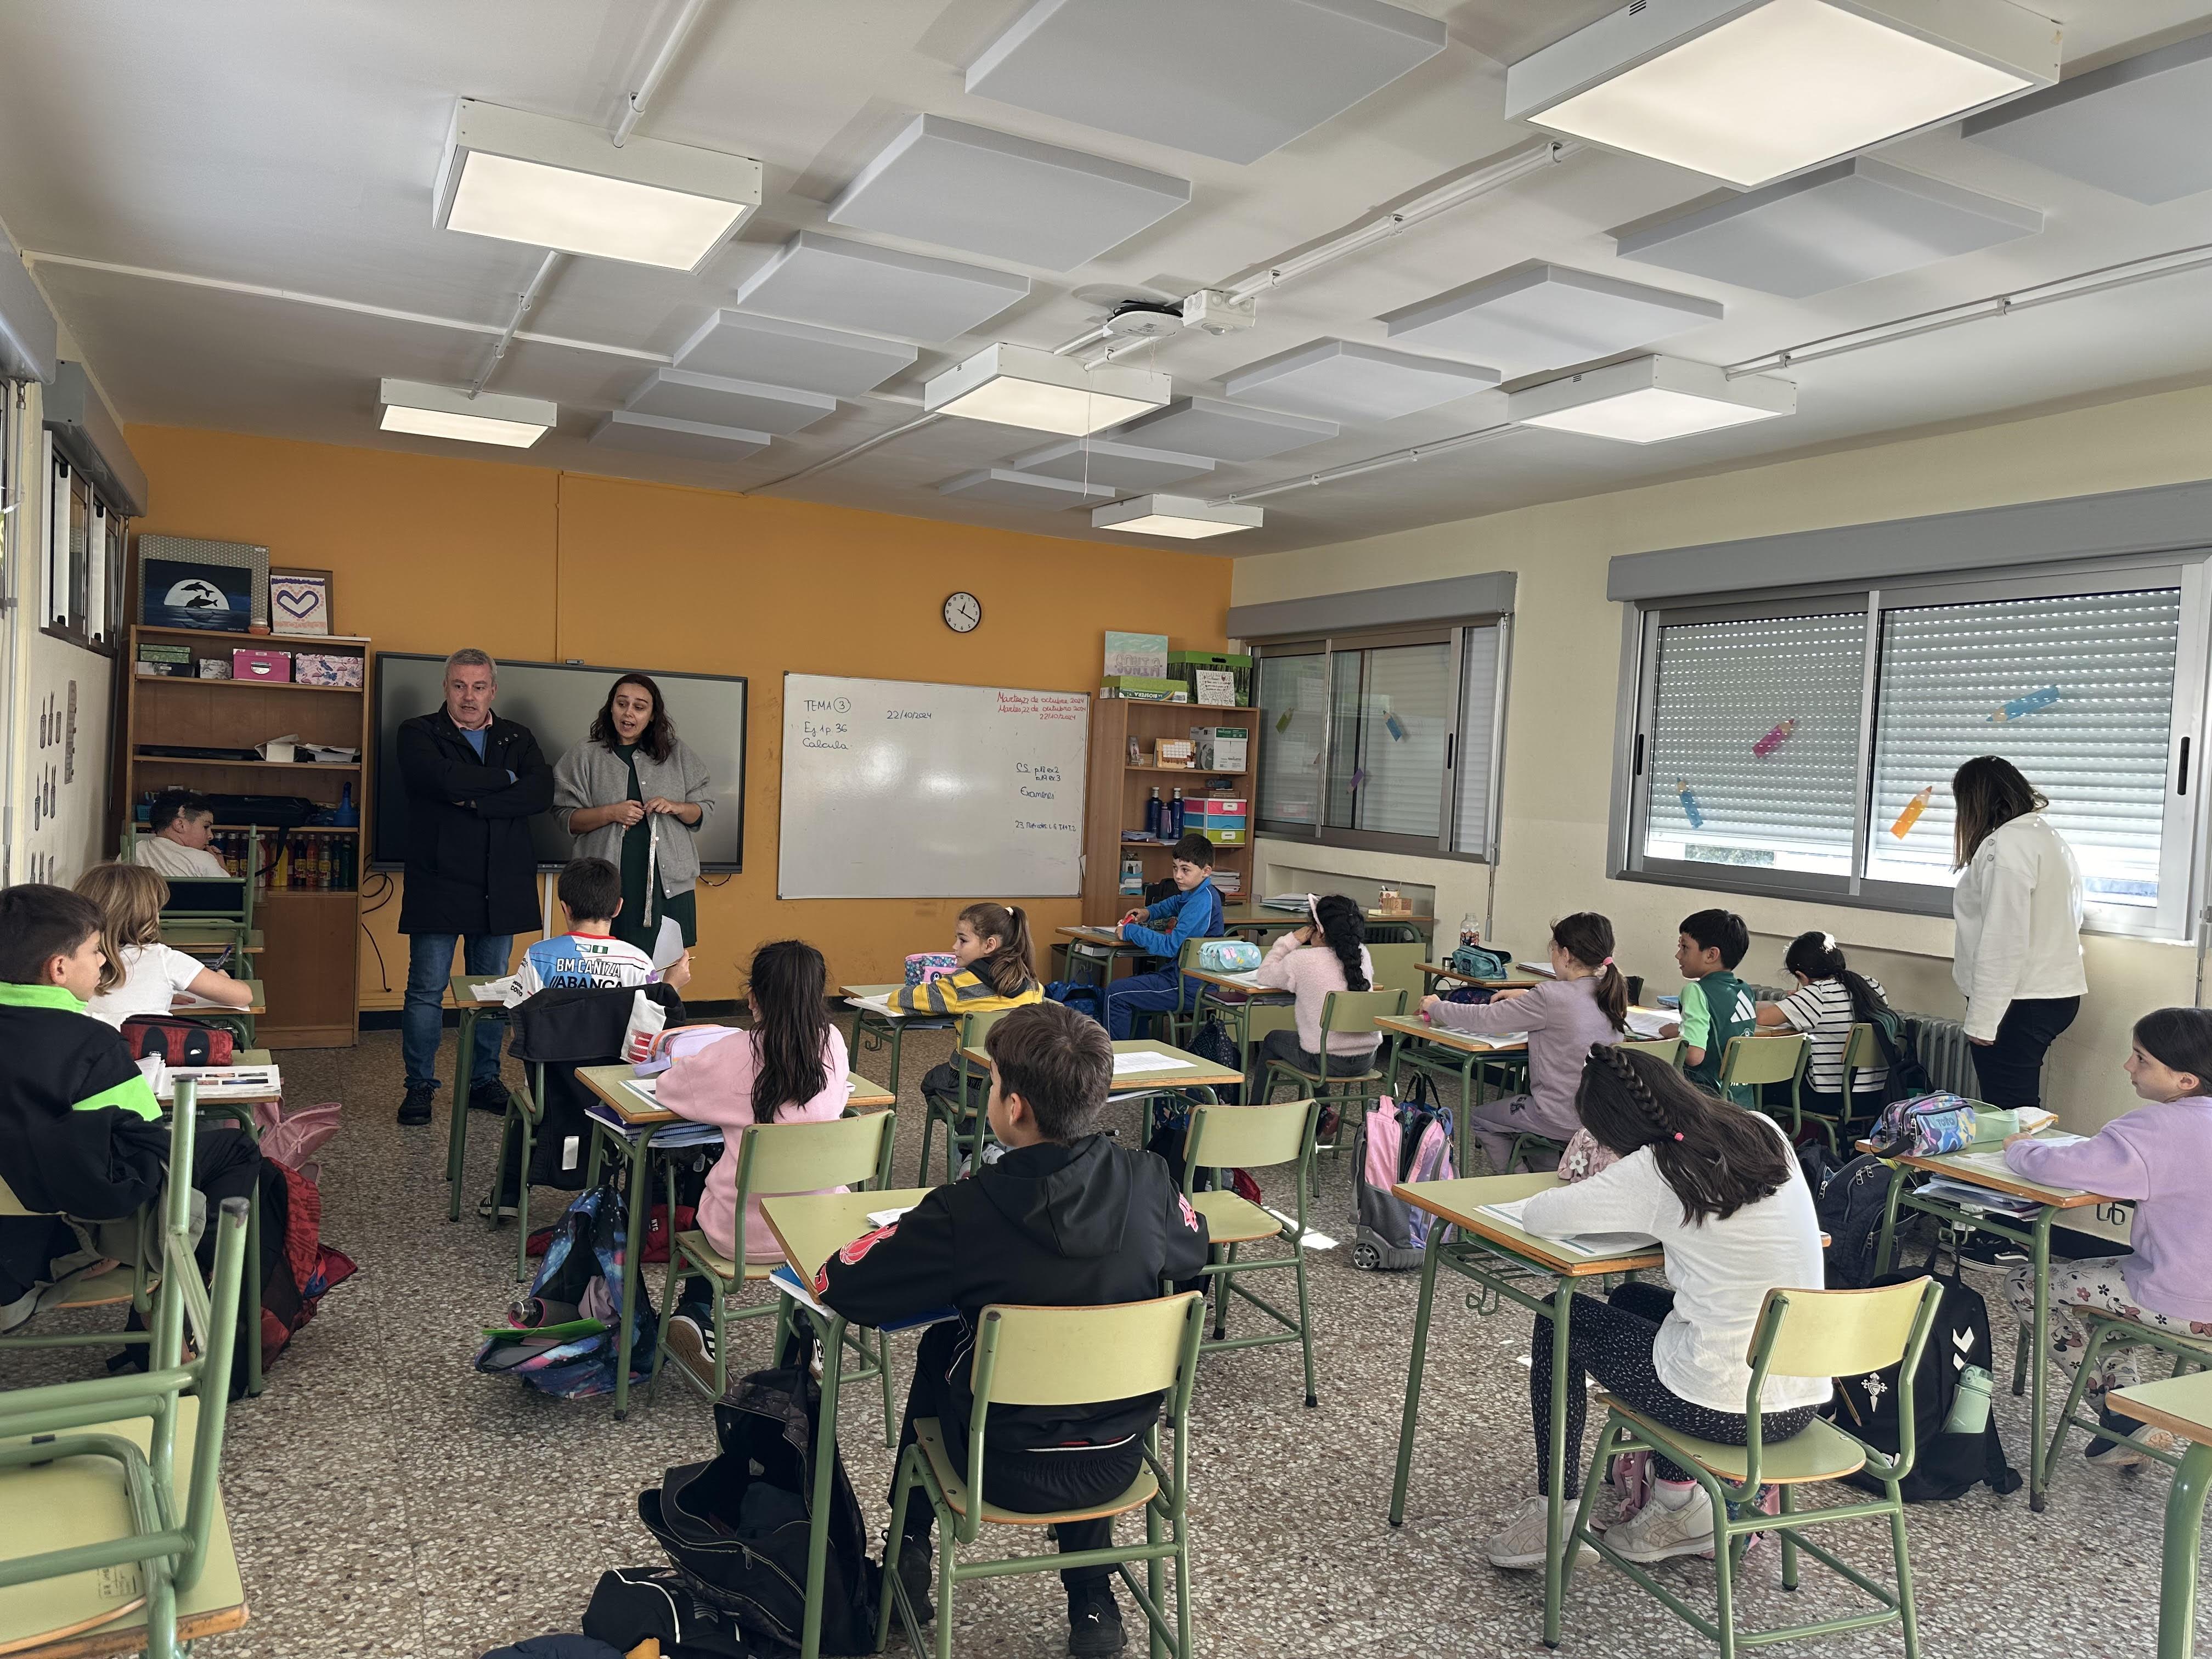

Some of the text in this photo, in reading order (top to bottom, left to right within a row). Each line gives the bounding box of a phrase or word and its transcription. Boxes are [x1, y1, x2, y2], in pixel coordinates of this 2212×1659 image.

[804, 700, 831, 712] TEMA
[887, 709, 932, 719] 22/10/2024
[836, 723, 848, 732] 36
[802, 737, 849, 750] Calcula
[1017, 763, 1029, 772] CS
[1015, 820, 1024, 829] 23
[556, 957, 621, 978] BM CAÑIZA
